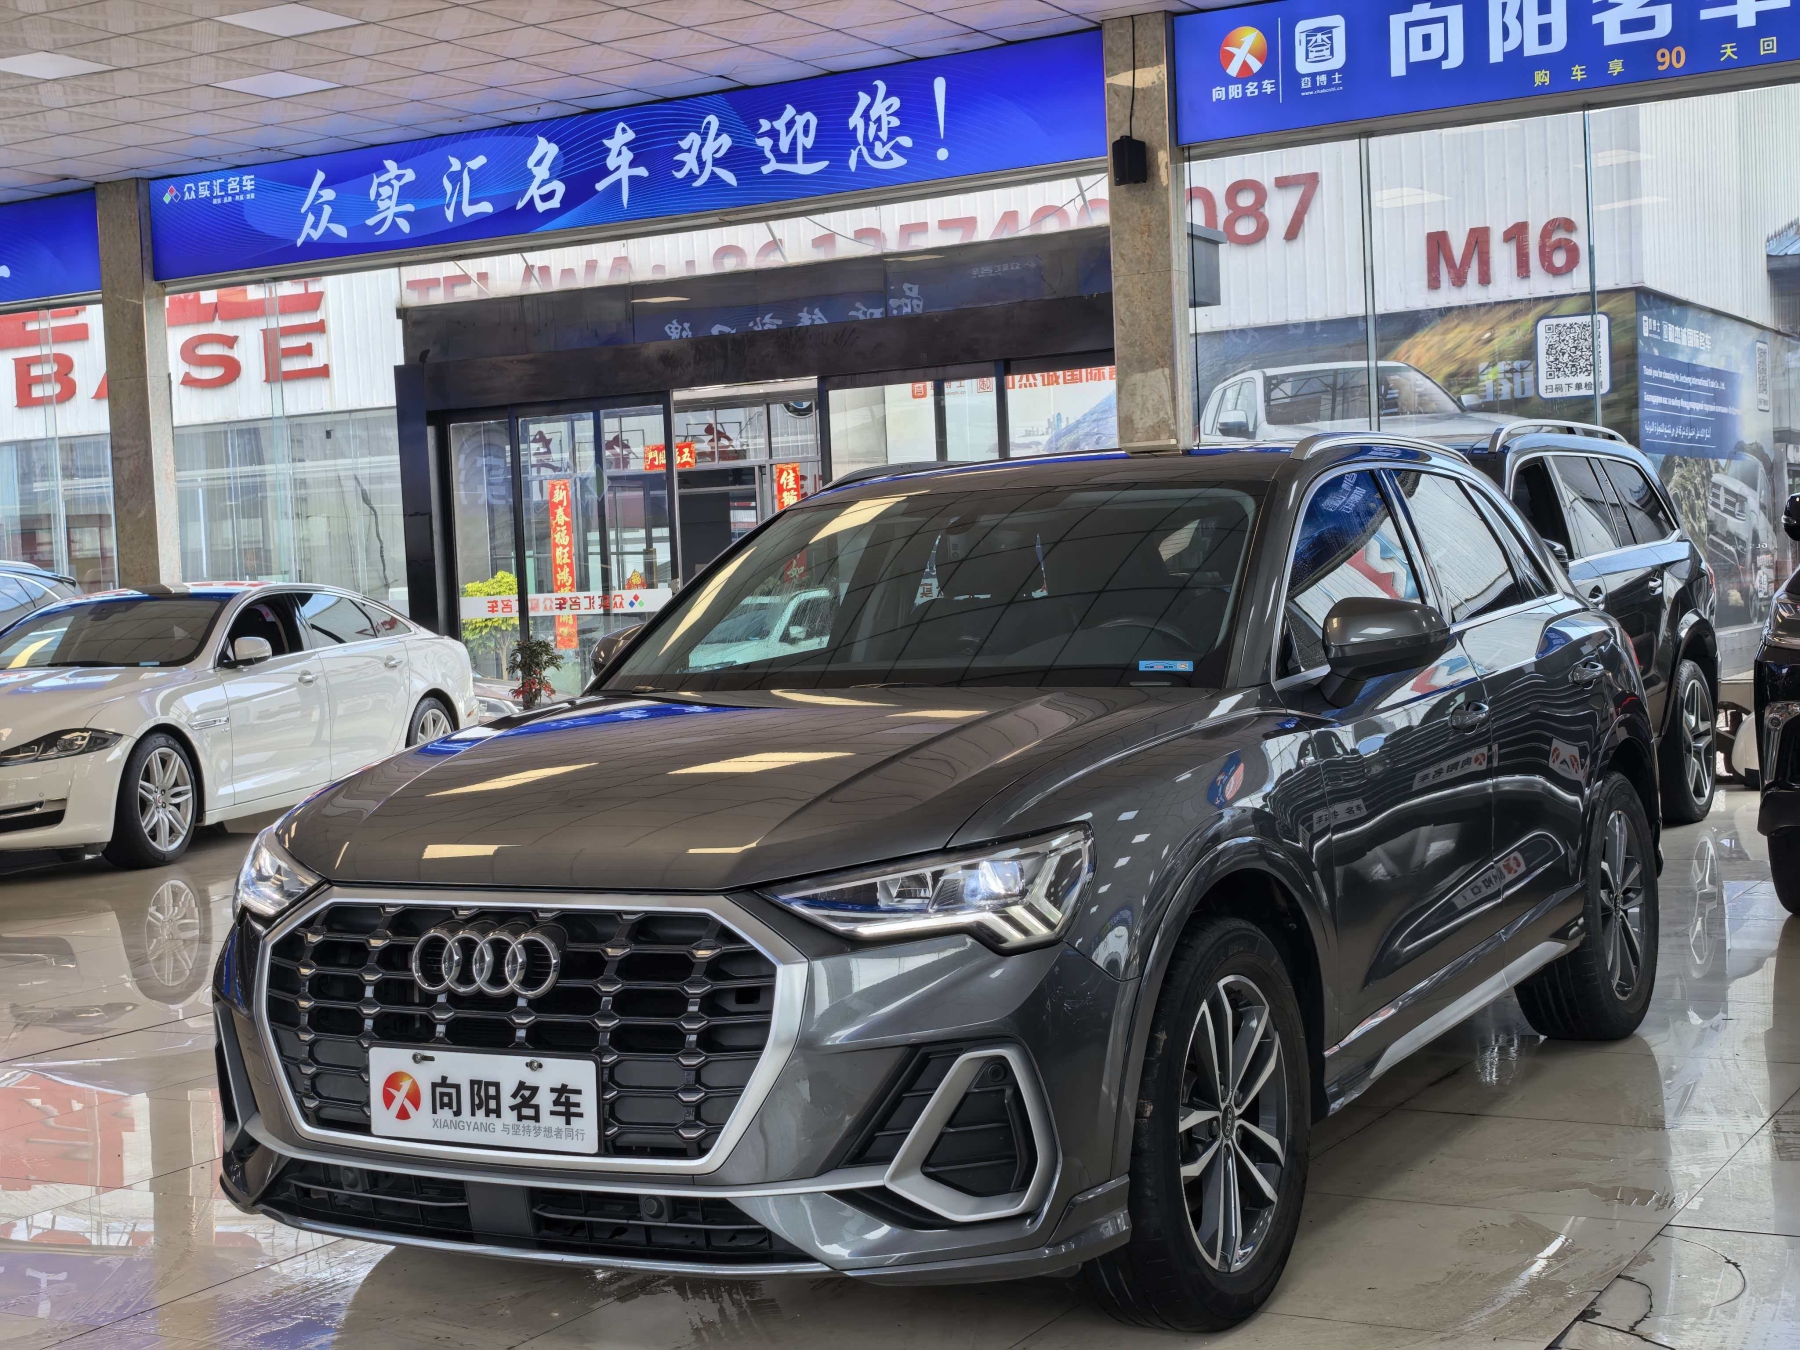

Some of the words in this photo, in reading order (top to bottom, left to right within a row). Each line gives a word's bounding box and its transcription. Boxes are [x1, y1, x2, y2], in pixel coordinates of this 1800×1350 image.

[1533, 58, 1625, 88] 购车享
[1656, 45, 1687, 71] 90
[1211, 79, 1277, 102] 向阳名车
[1300, 72, 1344, 89] 查博士
[183, 175, 255, 201] 众实汇名车
[1425, 216, 1581, 291] M16
[12, 318, 330, 408] BSE
[1544, 381, 1603, 394] 扫码下单检
[431, 1075, 584, 1126] 向阳名车
[432, 1117, 496, 1134] XIANGYANG
[500, 1122, 585, 1142] 与坚持梦想者同行
